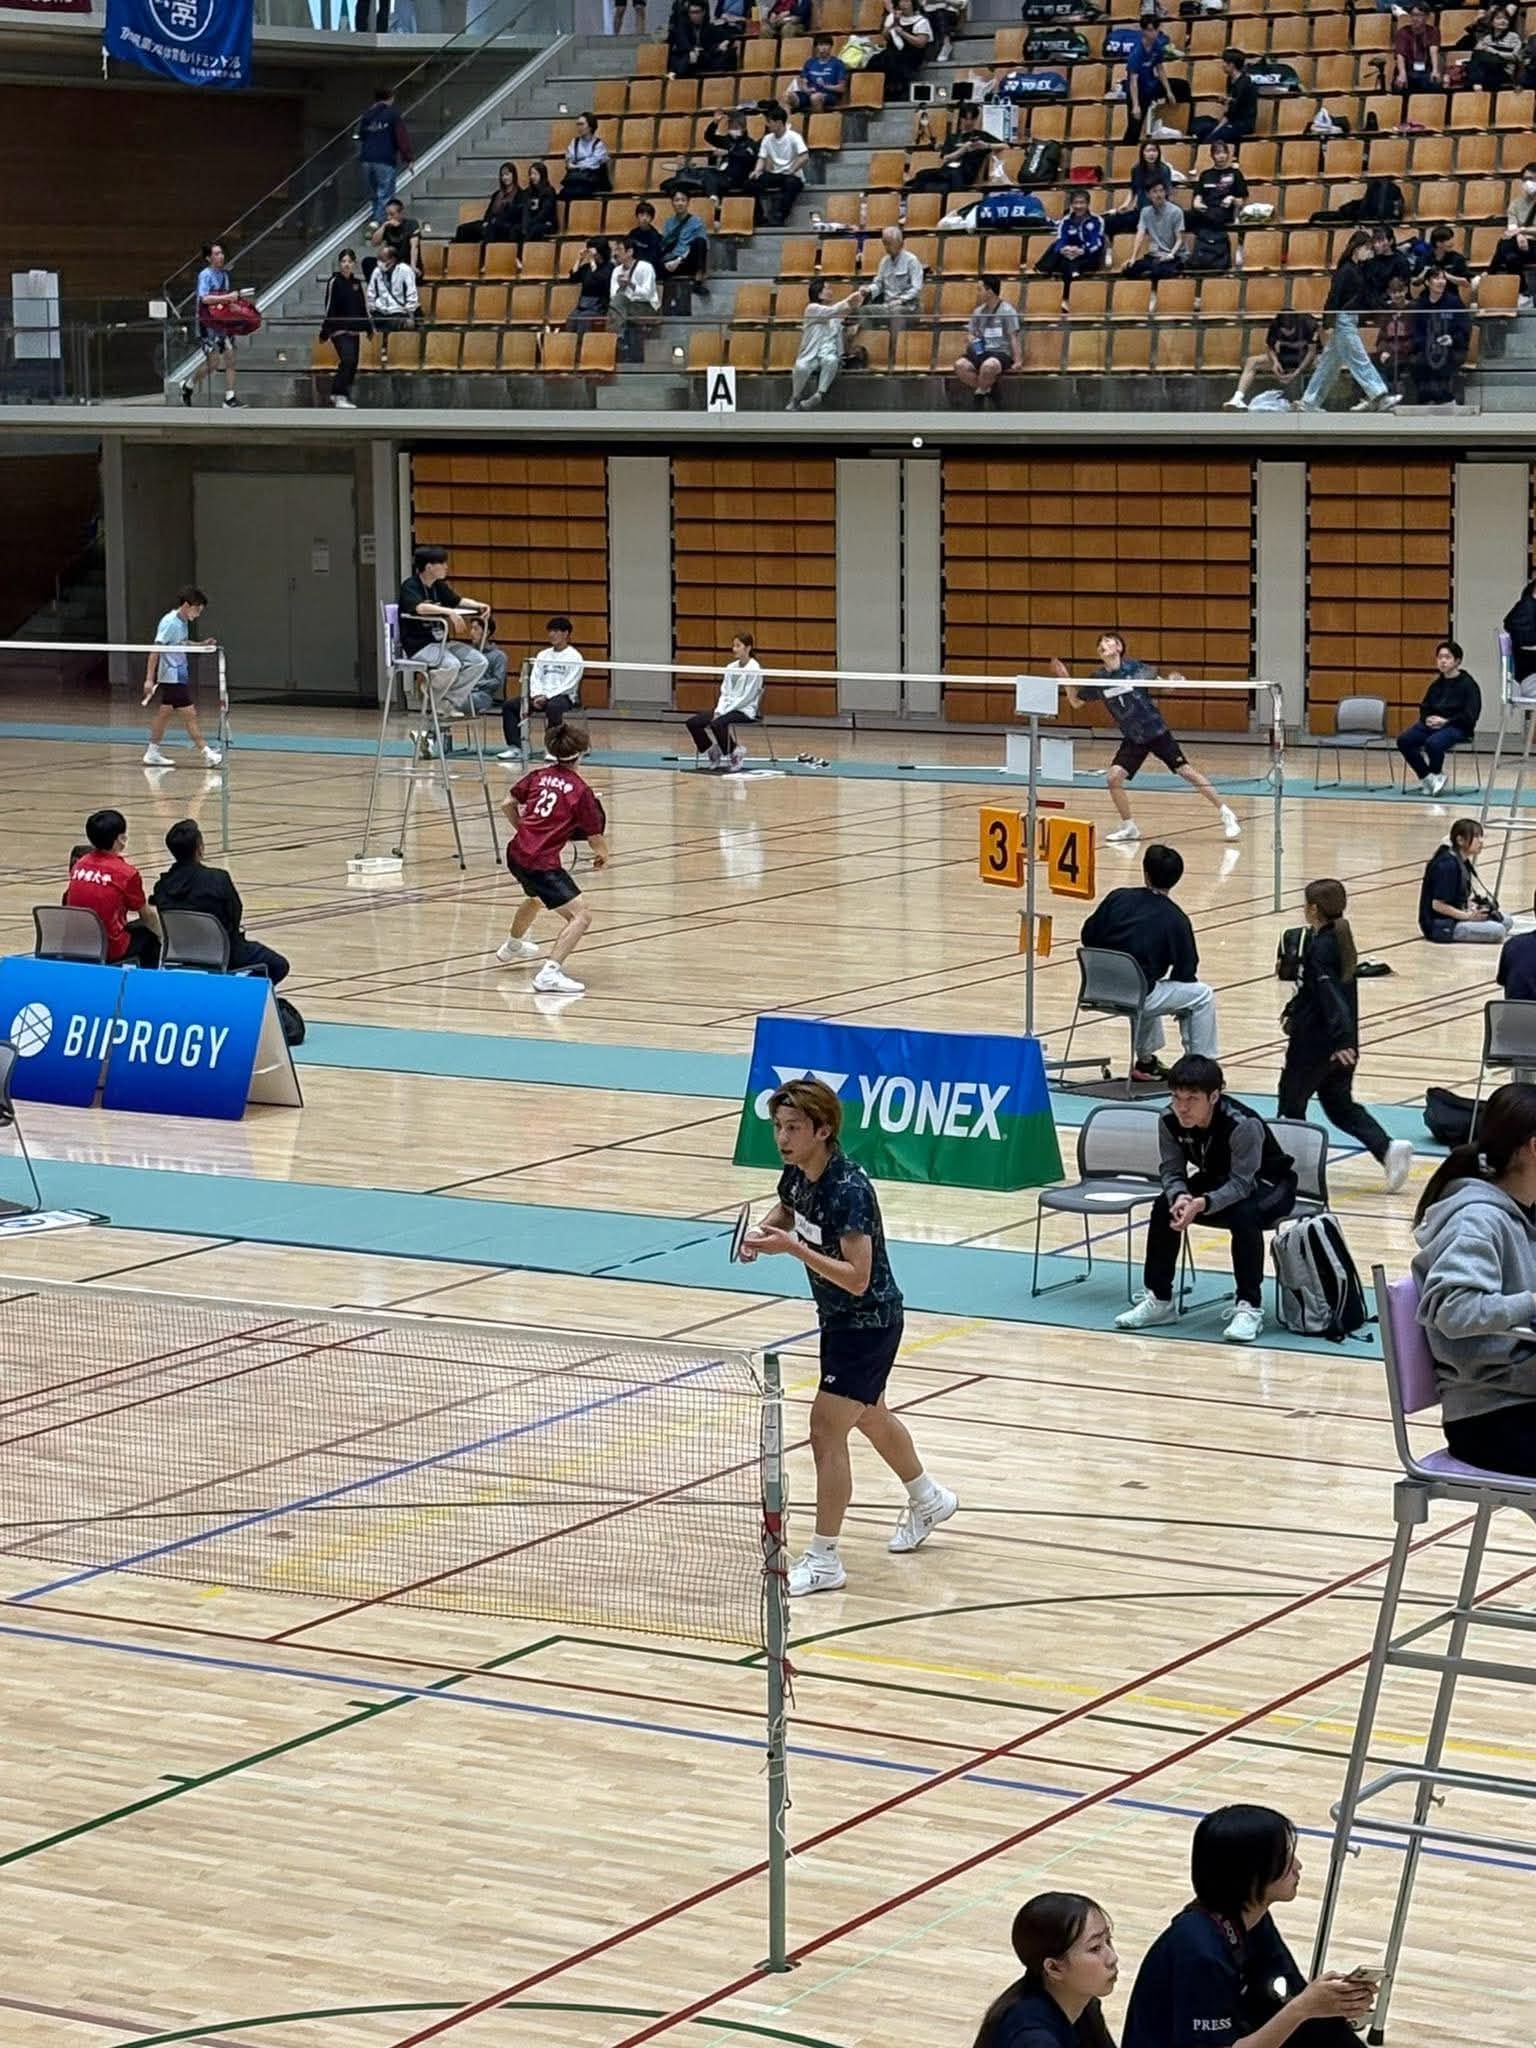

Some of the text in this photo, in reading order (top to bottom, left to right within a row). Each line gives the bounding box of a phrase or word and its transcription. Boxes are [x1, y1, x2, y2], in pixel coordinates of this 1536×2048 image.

[710, 373, 734, 406] A
[533, 789, 558, 817] 23
[989, 820, 1008, 871] 3
[1057, 832, 1080, 884] 4
[63, 1014, 230, 1069] BIPROGY
[858, 1075, 1011, 1141] YONEX
[1193, 2017, 1233, 2032] PRESS
